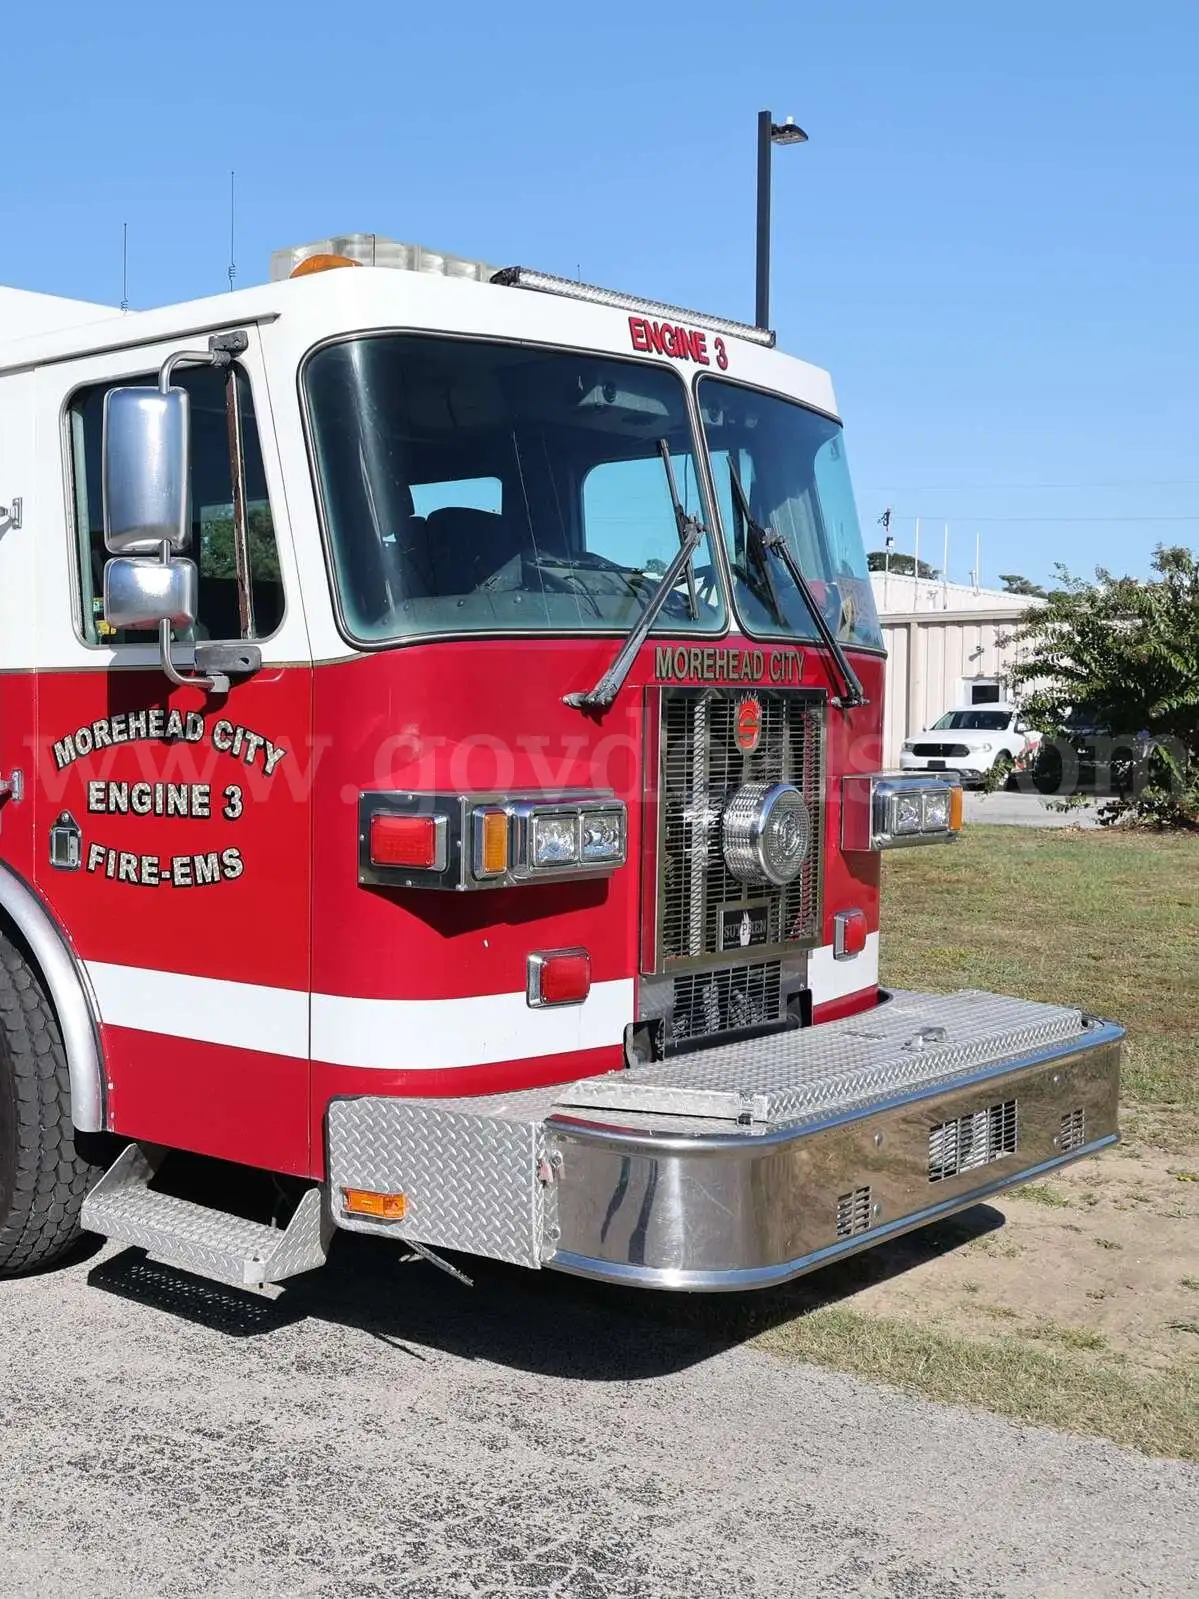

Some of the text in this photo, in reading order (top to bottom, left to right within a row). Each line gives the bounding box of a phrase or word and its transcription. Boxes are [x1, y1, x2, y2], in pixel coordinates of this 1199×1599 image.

[628, 316, 728, 371] ENGINE 3
[655, 646, 806, 682] MOREHEAD CITY
[53, 708, 287, 775] MOREHEAD CITY
[87, 780, 244, 820] ENGINE 3
[87, 843, 245, 887] FIRE-EMS
